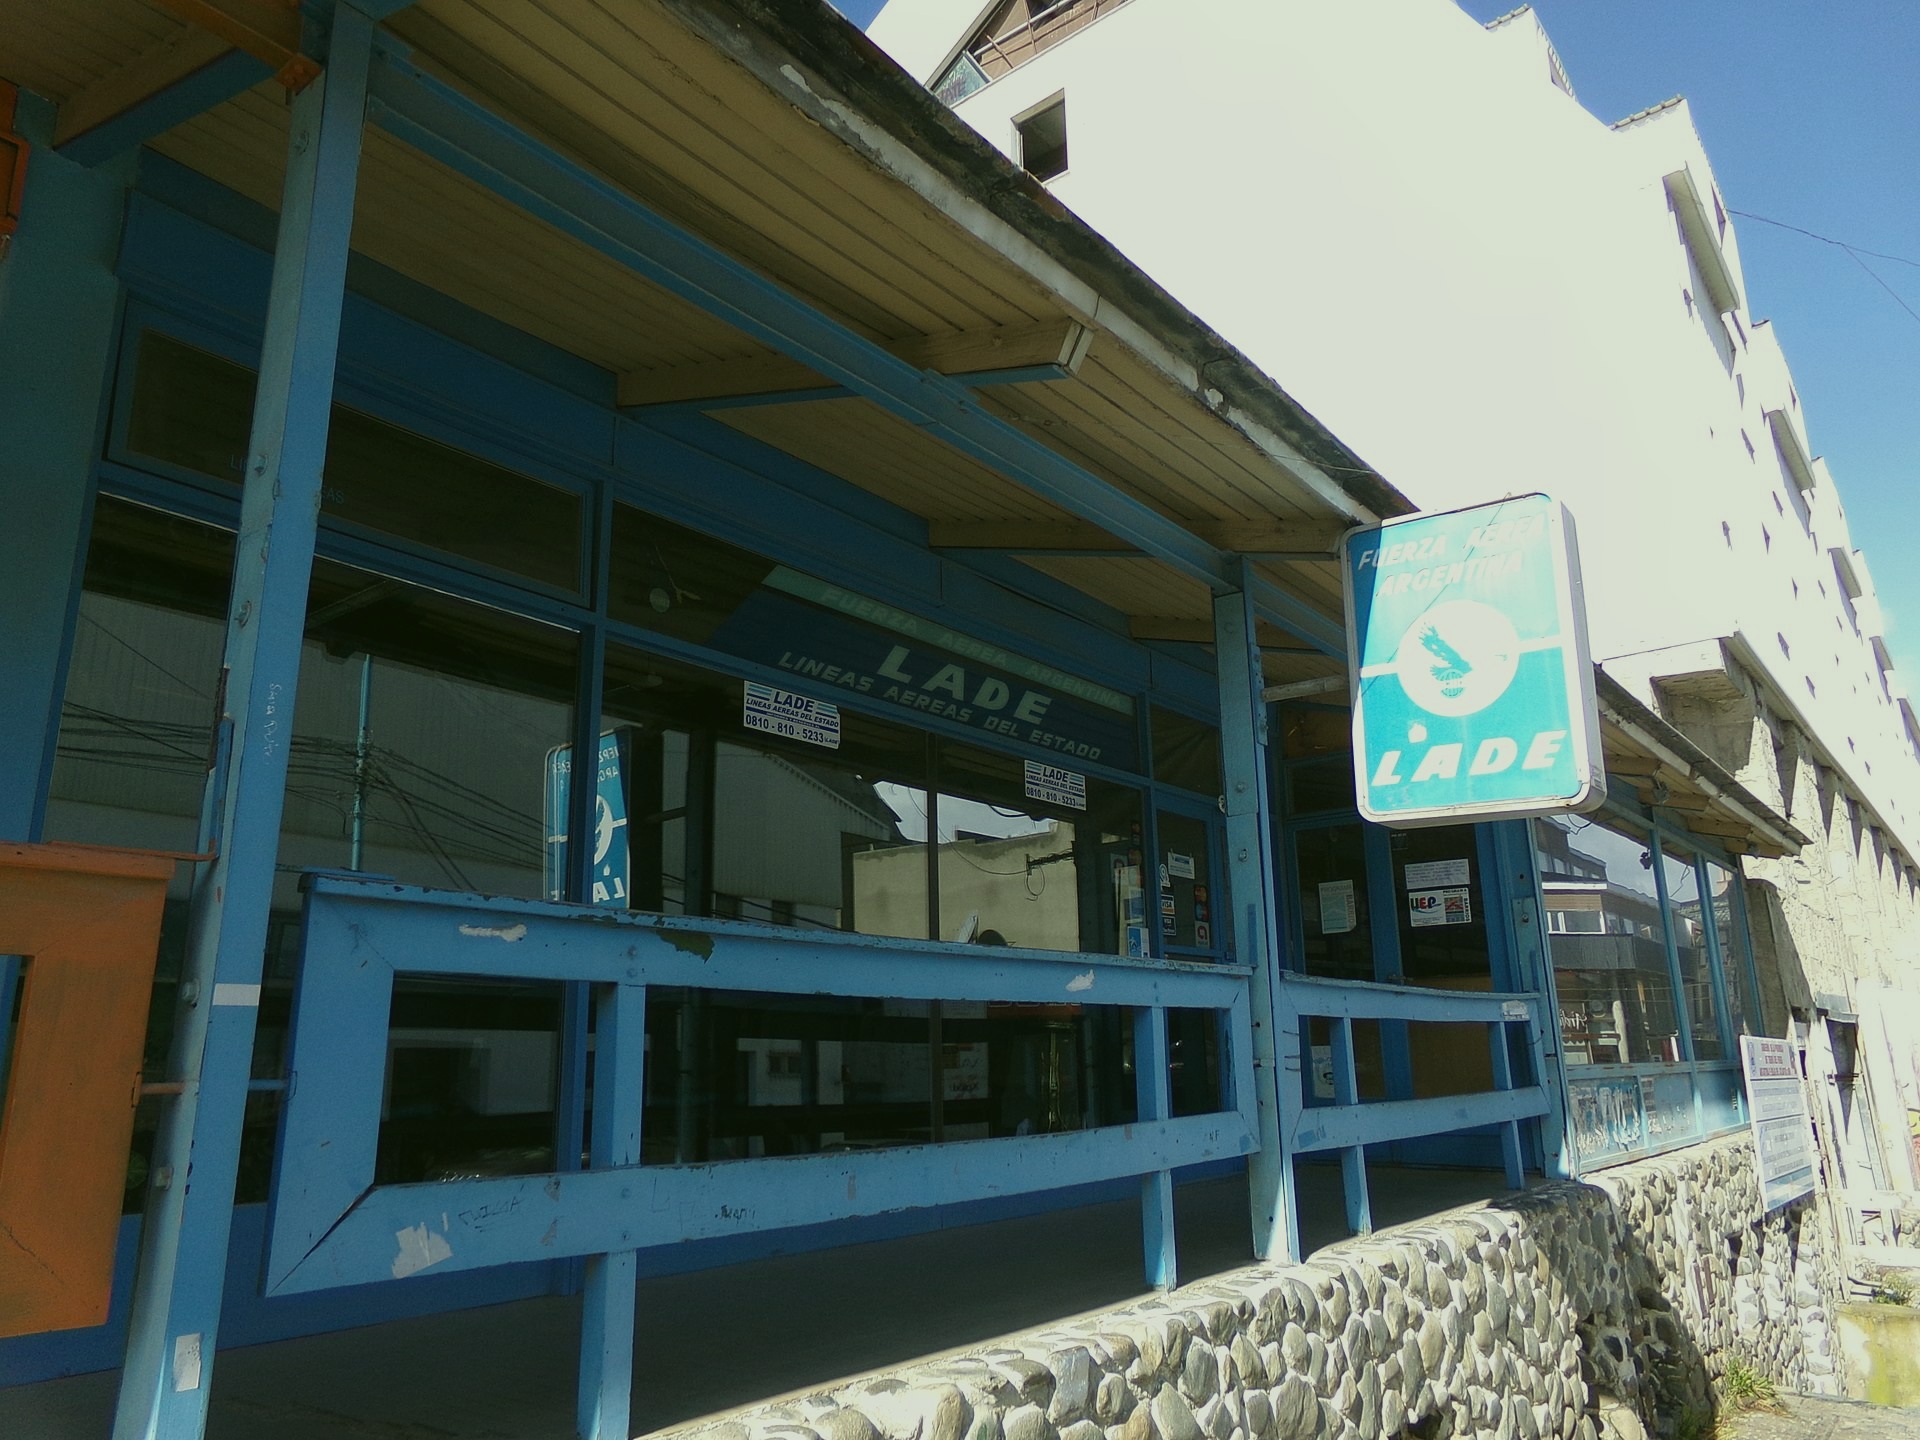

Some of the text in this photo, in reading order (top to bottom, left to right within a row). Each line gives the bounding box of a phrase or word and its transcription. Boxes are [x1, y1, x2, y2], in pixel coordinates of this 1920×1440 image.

[1358, 514, 1546, 571] FUERZA AEREA
[1375, 552, 1525, 598] ARGENTINA
[820, 586, 1121, 707] FUERZA AEREA ARGENTINA
[773, 691, 815, 713] LADE
[778, 651, 1101, 761] LINEAS AEREAS DEL ESTADO
[877, 645, 1052, 726] LADE
[745, 714, 769, 730] 0810
[777, 722, 794, 736] 810
[802, 728, 824, 743] 5233
[746, 698, 771, 710] LINEAS
[773, 705, 799, 718] AEREAS
[800, 712, 813, 721] DEL
[814, 716, 839, 728] ESTADO
[1043, 767, 1069, 783] LADE
[1371, 729, 1568, 787] LADE
